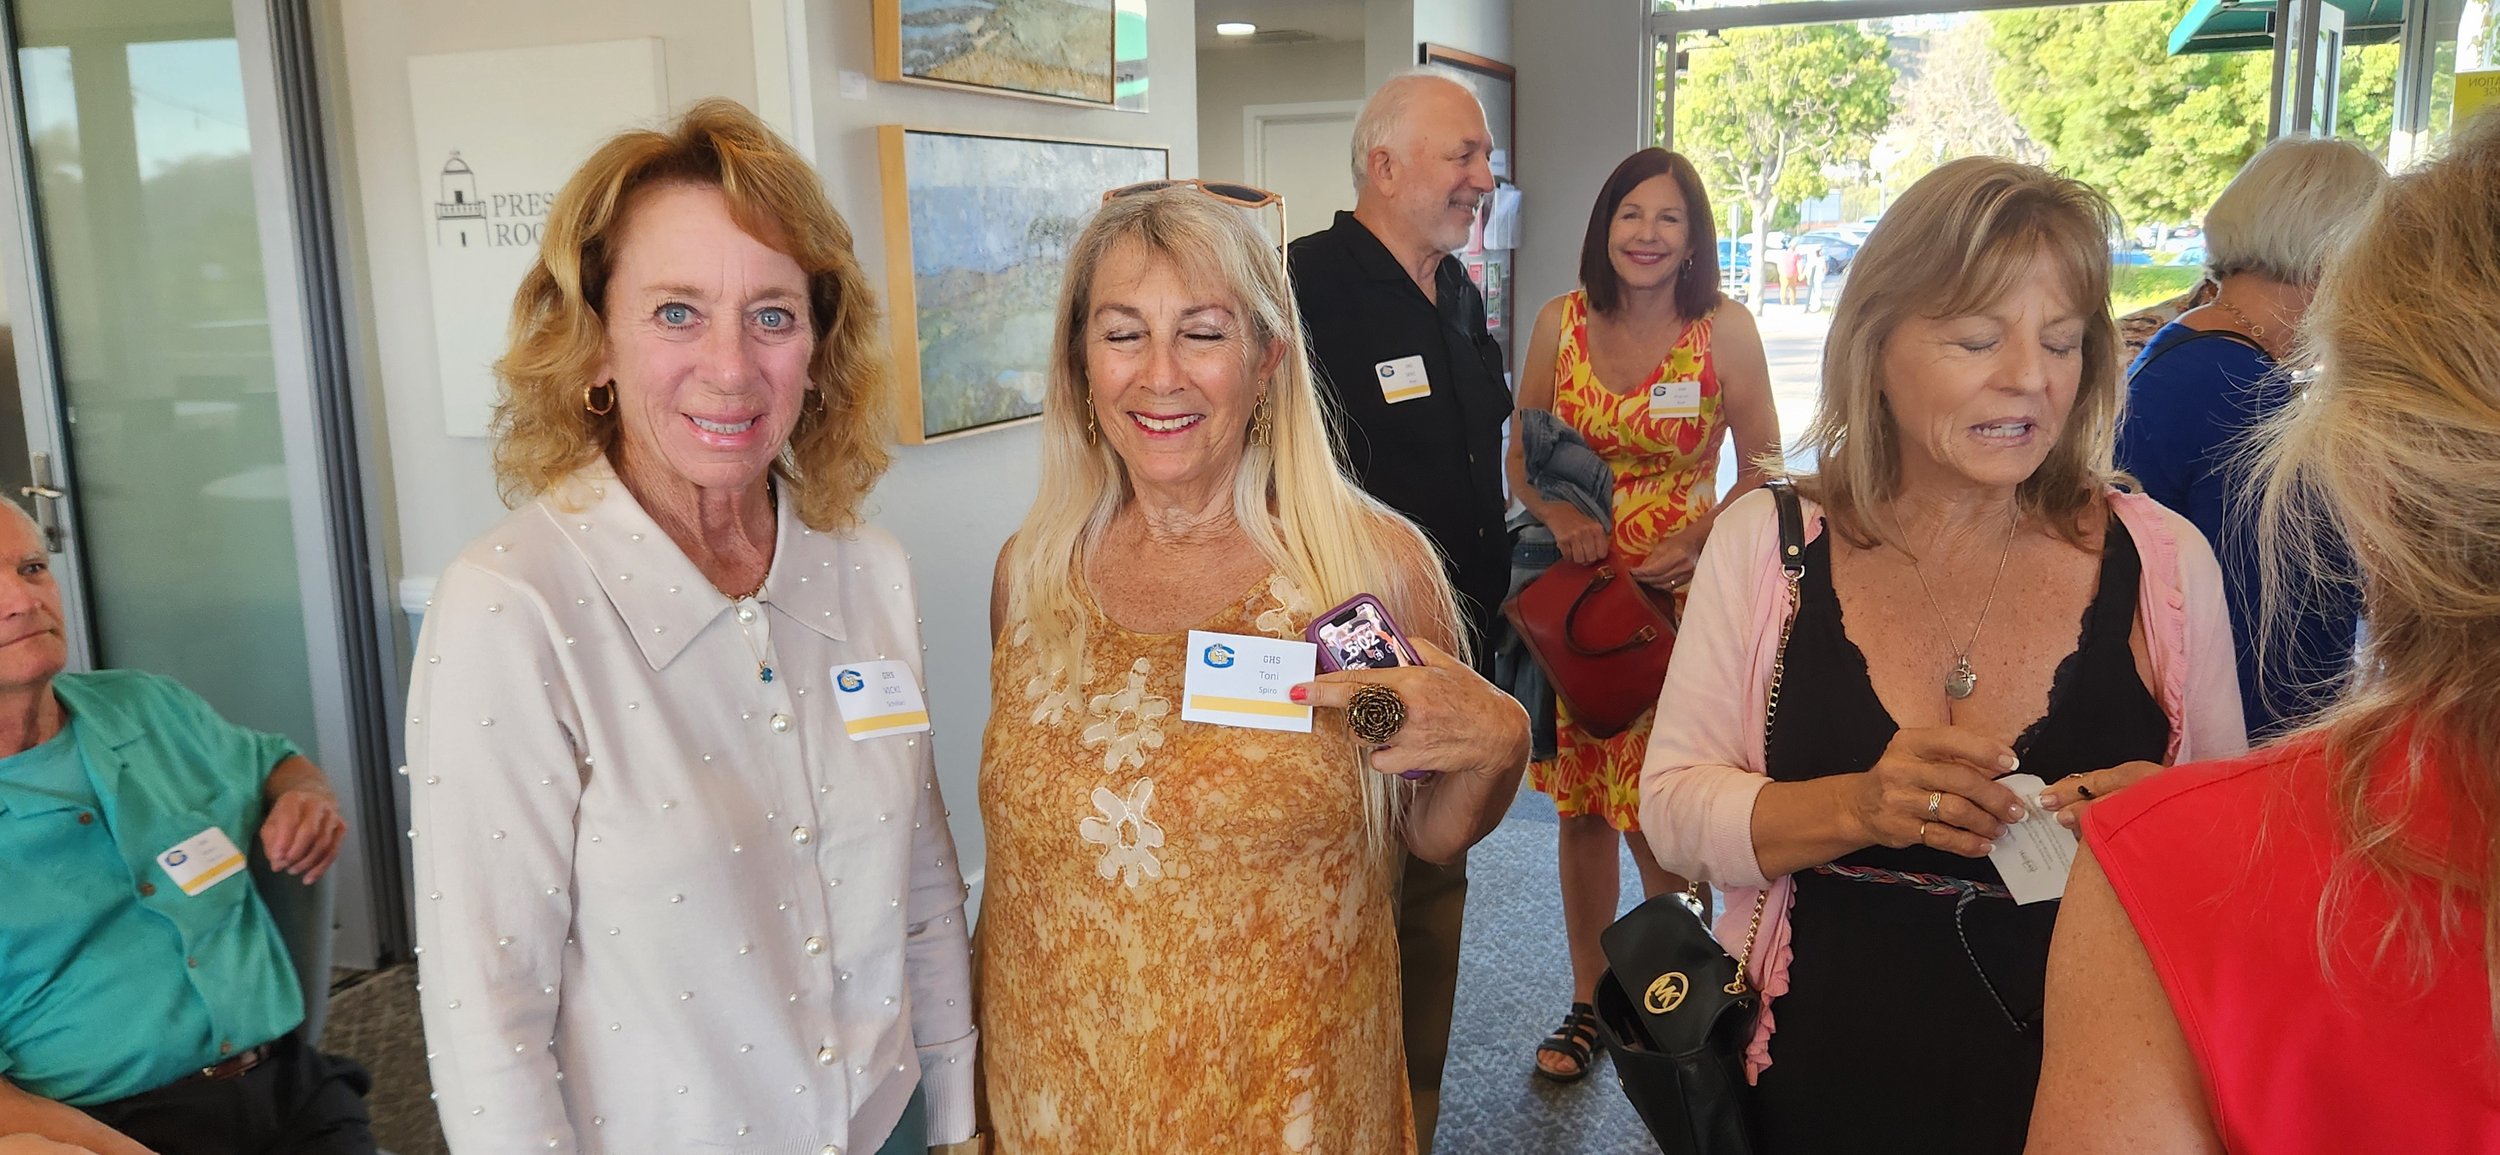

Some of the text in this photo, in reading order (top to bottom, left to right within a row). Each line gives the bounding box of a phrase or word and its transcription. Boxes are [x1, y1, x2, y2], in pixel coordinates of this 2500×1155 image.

[1344, 629, 1380, 657] 5:02
[1263, 655, 1281, 665] GHS
[1259, 670, 1279, 681] Toni
[1258, 686, 1278, 695] Spiro
